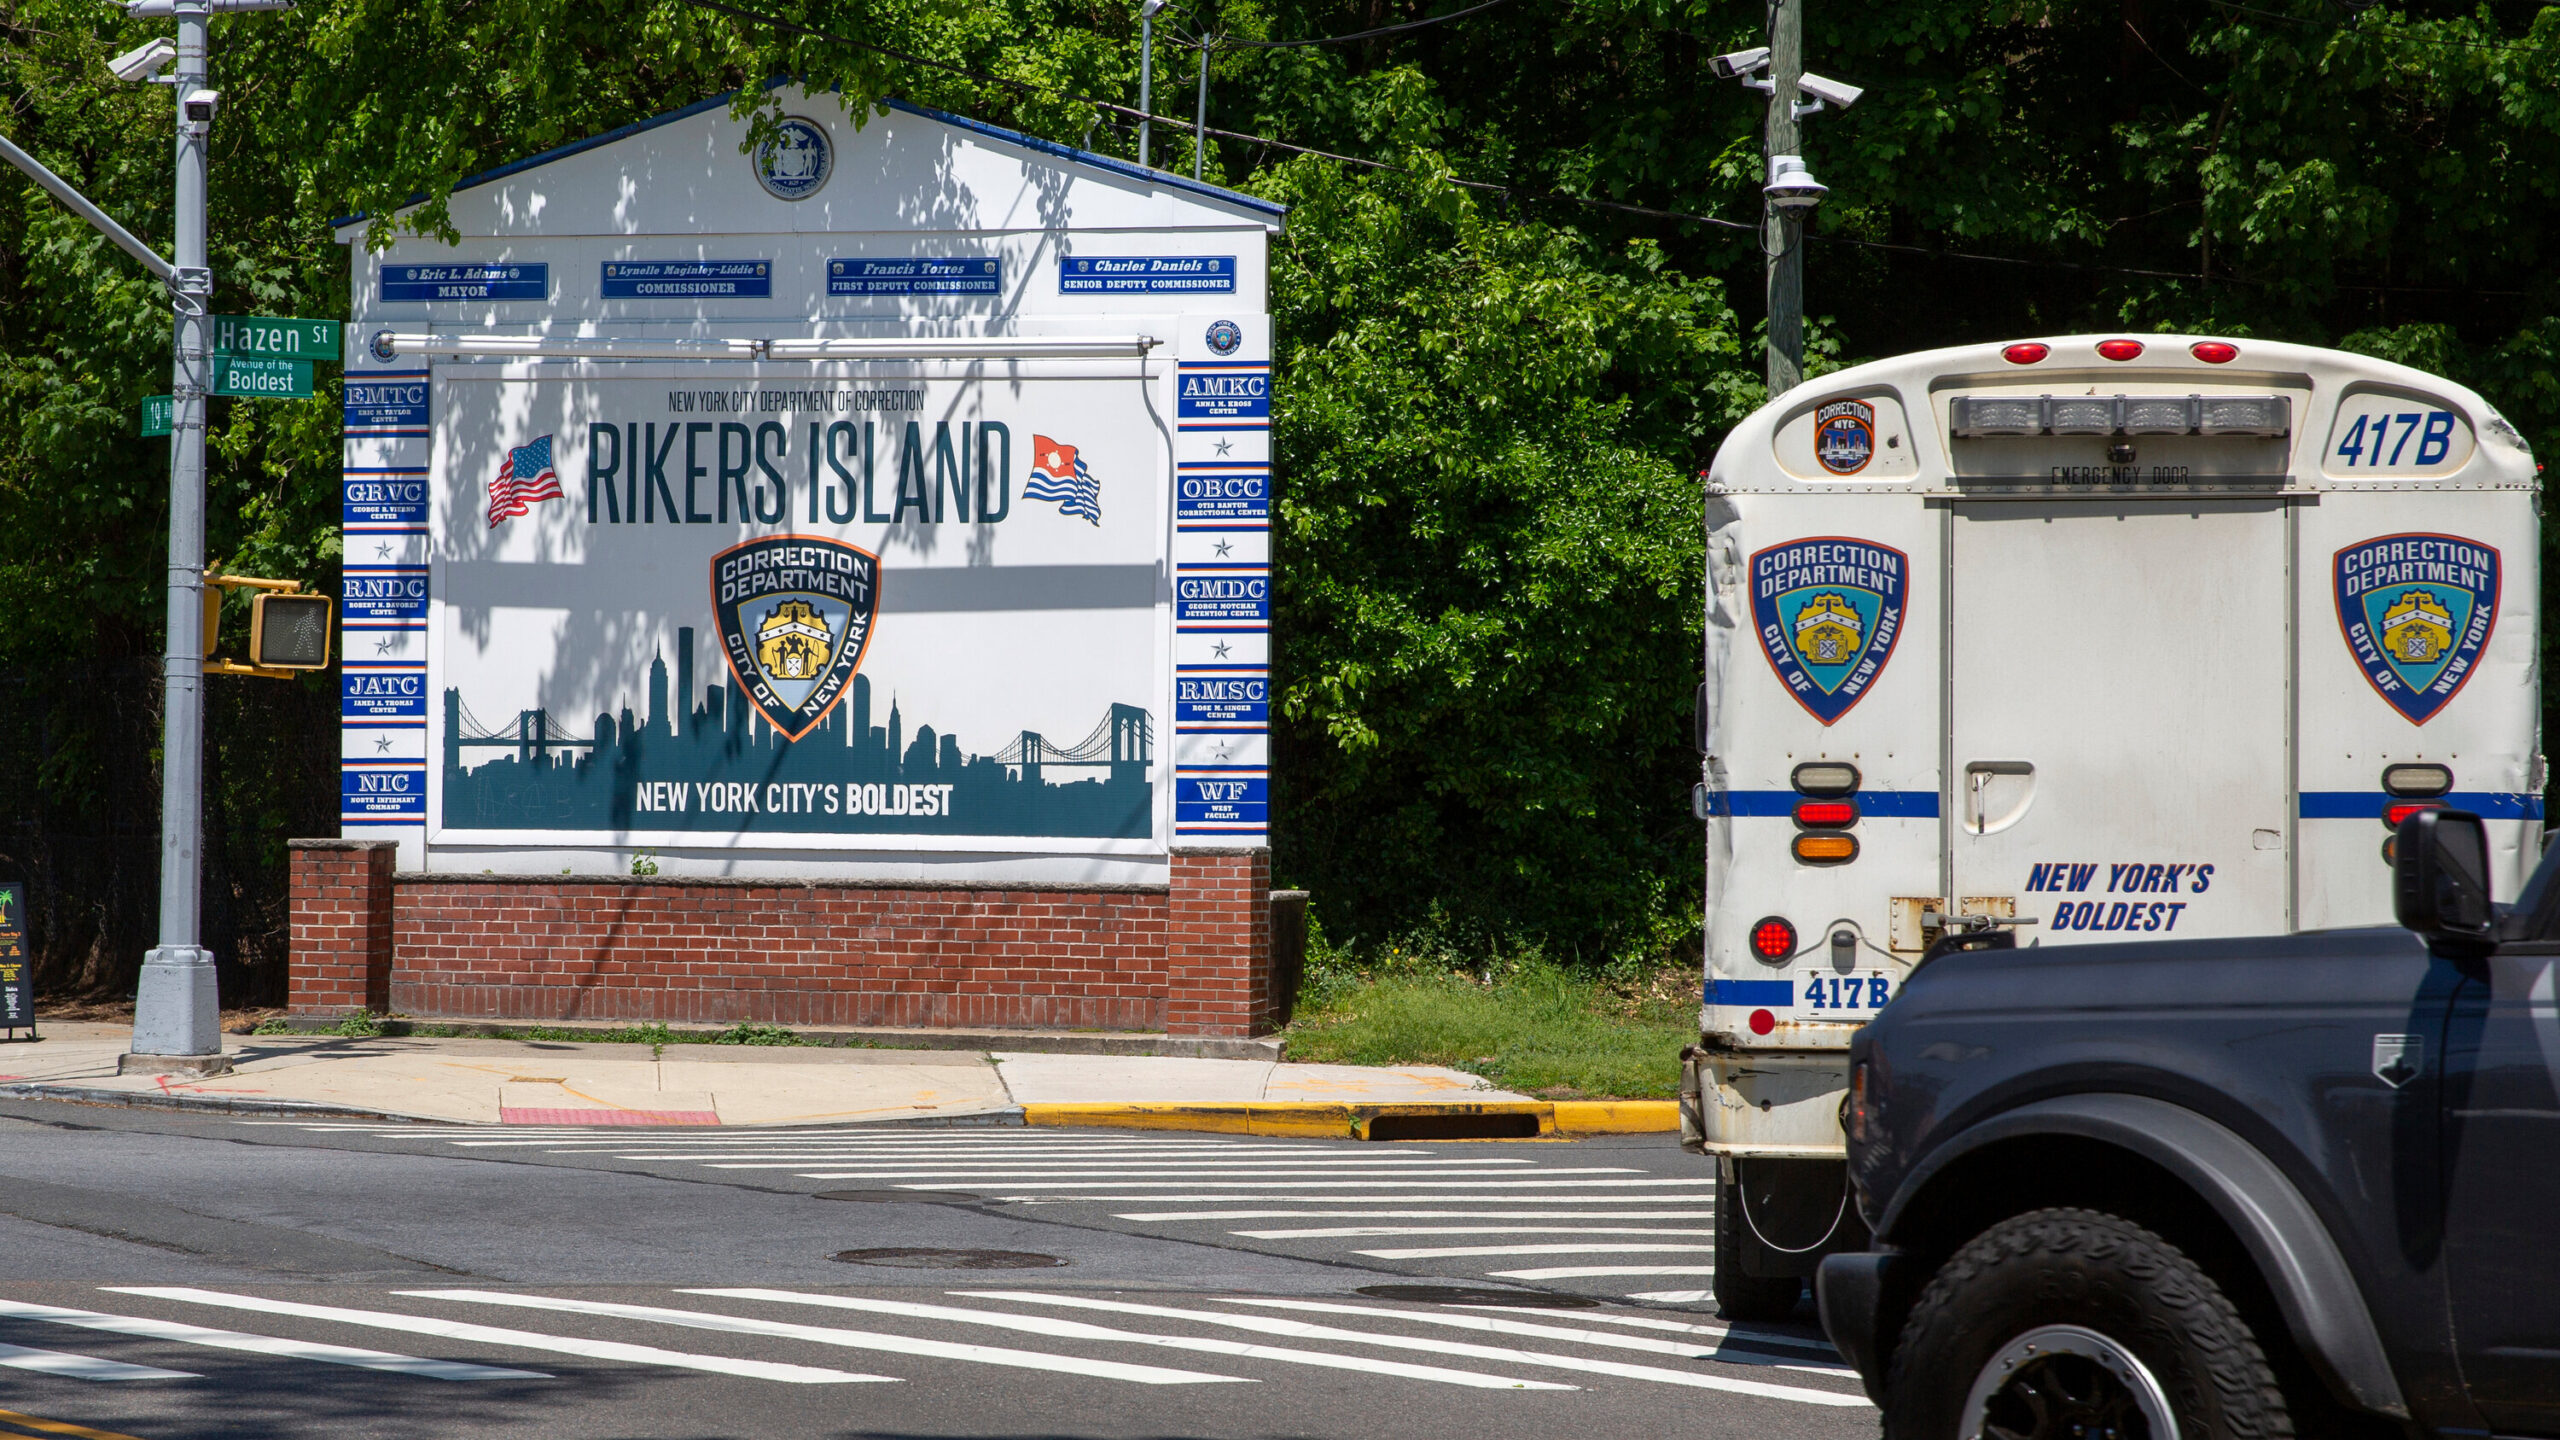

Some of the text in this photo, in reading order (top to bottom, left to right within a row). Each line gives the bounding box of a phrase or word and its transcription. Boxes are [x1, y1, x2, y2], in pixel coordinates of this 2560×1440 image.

[419, 268, 507, 280] Eric L. Adams
[619, 265, 753, 276] Lynelle Maginley-Liddie
[863, 263, 965, 274] Francis Torres
[1095, 260, 1202, 271] Charles Daniels
[438, 286, 487, 296] MAYOR
[637, 283, 736, 293] COMMISSIONER
[832, 281, 995, 291] FIRST DEPUTY COMMISSIONER
[1107, 280, 1147, 288] DEPUTY
[1151, 280, 1230, 288] COMMISSIONER
[221, 322, 328, 352] Hazen St
[230, 358, 293, 370] Avenue of the
[229, 371, 293, 391] Boldest
[1183, 377, 1264, 396] AMKC
[346, 386, 423, 404] EMTC
[668, 390, 924, 412] NEW YORK CITY DEPARTMENT OF CORRECTION
[151, 402, 160, 430] 19
[1818, 402, 1871, 424] CORRECTION
[1834, 420, 1855, 429] NYC
[2337, 412, 2455, 466] 417B
[588, 421, 1011, 524] RIKERS ISLAND
[2052, 466, 2188, 484] EMERGENCY DOOR
[347, 483, 422, 501] GRVC
[1183, 478, 1262, 497] OBCC
[722, 547, 868, 582] CORRECTION
[1759, 545, 1897, 576] CORRECTION
[2344, 542, 2488, 574] CORRECTION
[344, 579, 424, 597] RNDC
[721, 569, 868, 604] DEPARTMENT
[1180, 579, 1265, 598] GMDC
[1761, 565, 1896, 598] DEPARTMENT
[2346, 562, 2488, 597] DEPARTMENT
[1764, 624, 1812, 693] CITY OF
[1842, 607, 1899, 695] NEW YORK
[2350, 622, 2400, 692] CITY OF
[2432, 603, 2491, 694] NEW YORK
[728, 632, 780, 711] CITY OF
[802, 610, 868, 717] NEW YORK
[349, 676, 418, 694] JATC
[1180, 681, 1264, 700] RMSC
[358, 774, 409, 792] NIC
[1197, 782, 1247, 800] WF
[636, 782, 953, 816] NEW YORK CITY'S BOLDEST
[2025, 863, 2215, 893] NEW YORK'S
[2051, 901, 2187, 931] BOLDEST
[1805, 978, 1891, 1008] 417B
